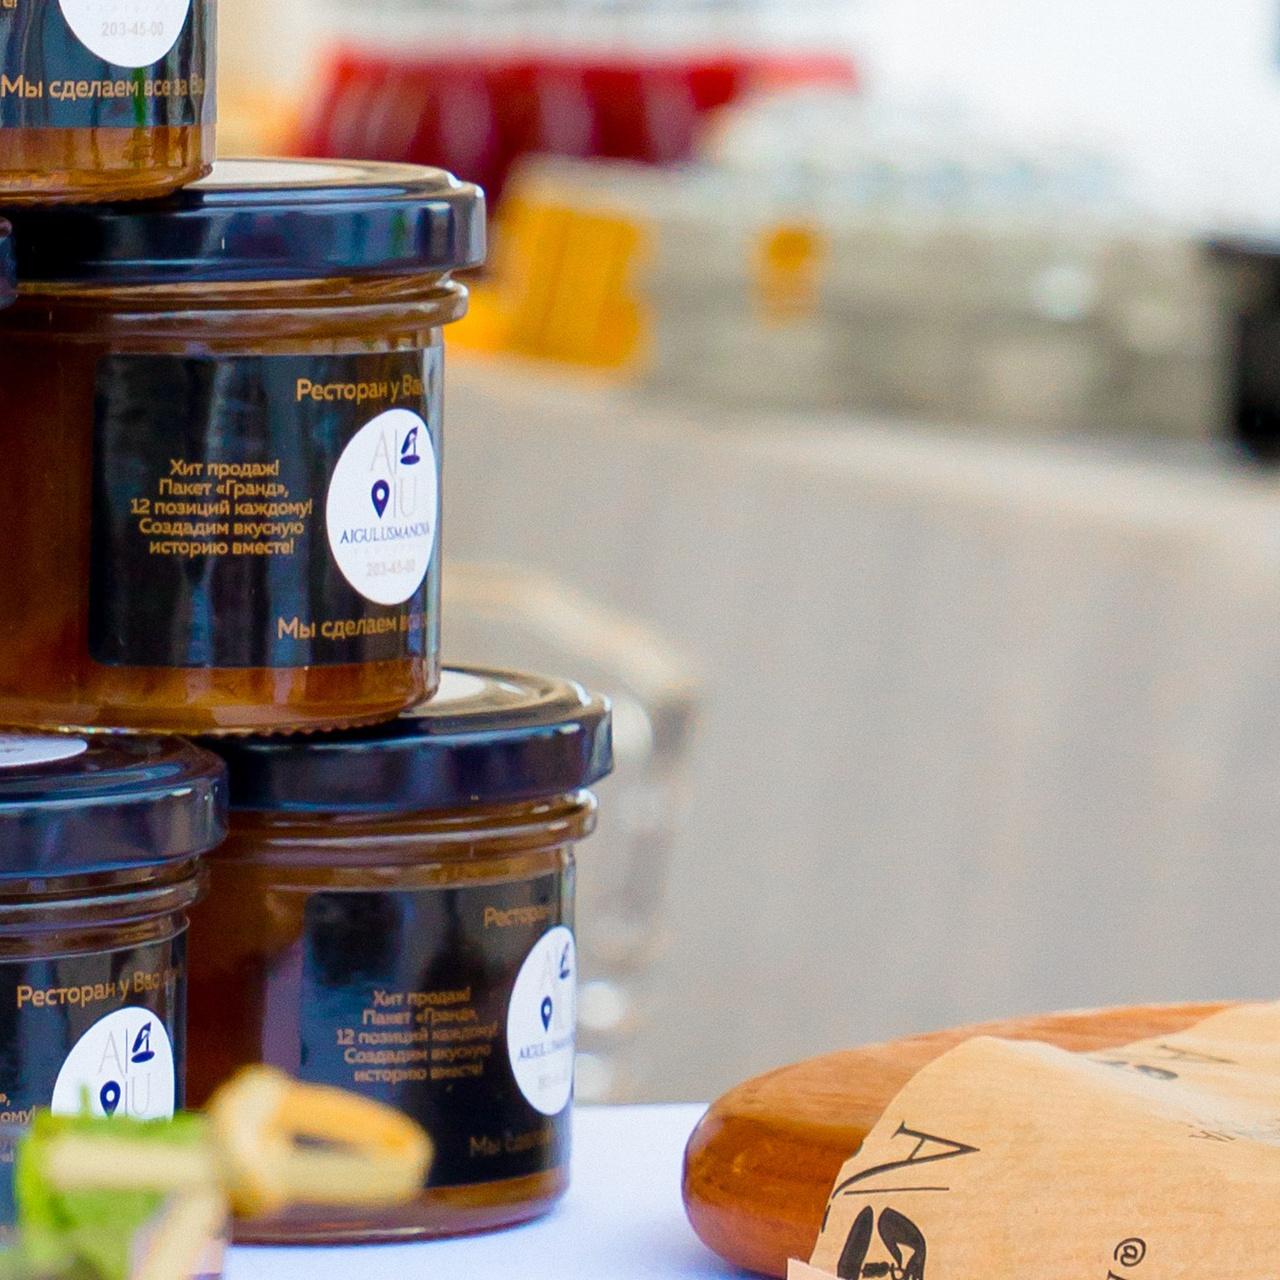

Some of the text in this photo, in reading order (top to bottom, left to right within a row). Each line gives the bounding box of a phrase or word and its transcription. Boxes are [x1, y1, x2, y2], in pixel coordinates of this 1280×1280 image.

[1, 76, 43, 97] Мы
[49, 78, 138, 101] сделаем
[296, 378, 400, 405] Ресторан у
[170, 459, 279, 478] Хит продаж!
[160, 480, 288, 498] Пакет «Гранд»,
[131, 499, 312, 517] 12 позиций каждому!
[140, 519, 304, 536] Создадим вкусную
[150, 540, 294, 557] историю вместе!
[278, 616, 316, 640] Мы
[321, 616, 396, 640] сделаем
[17, 970, 160, 1009] Ресторан у Вас
